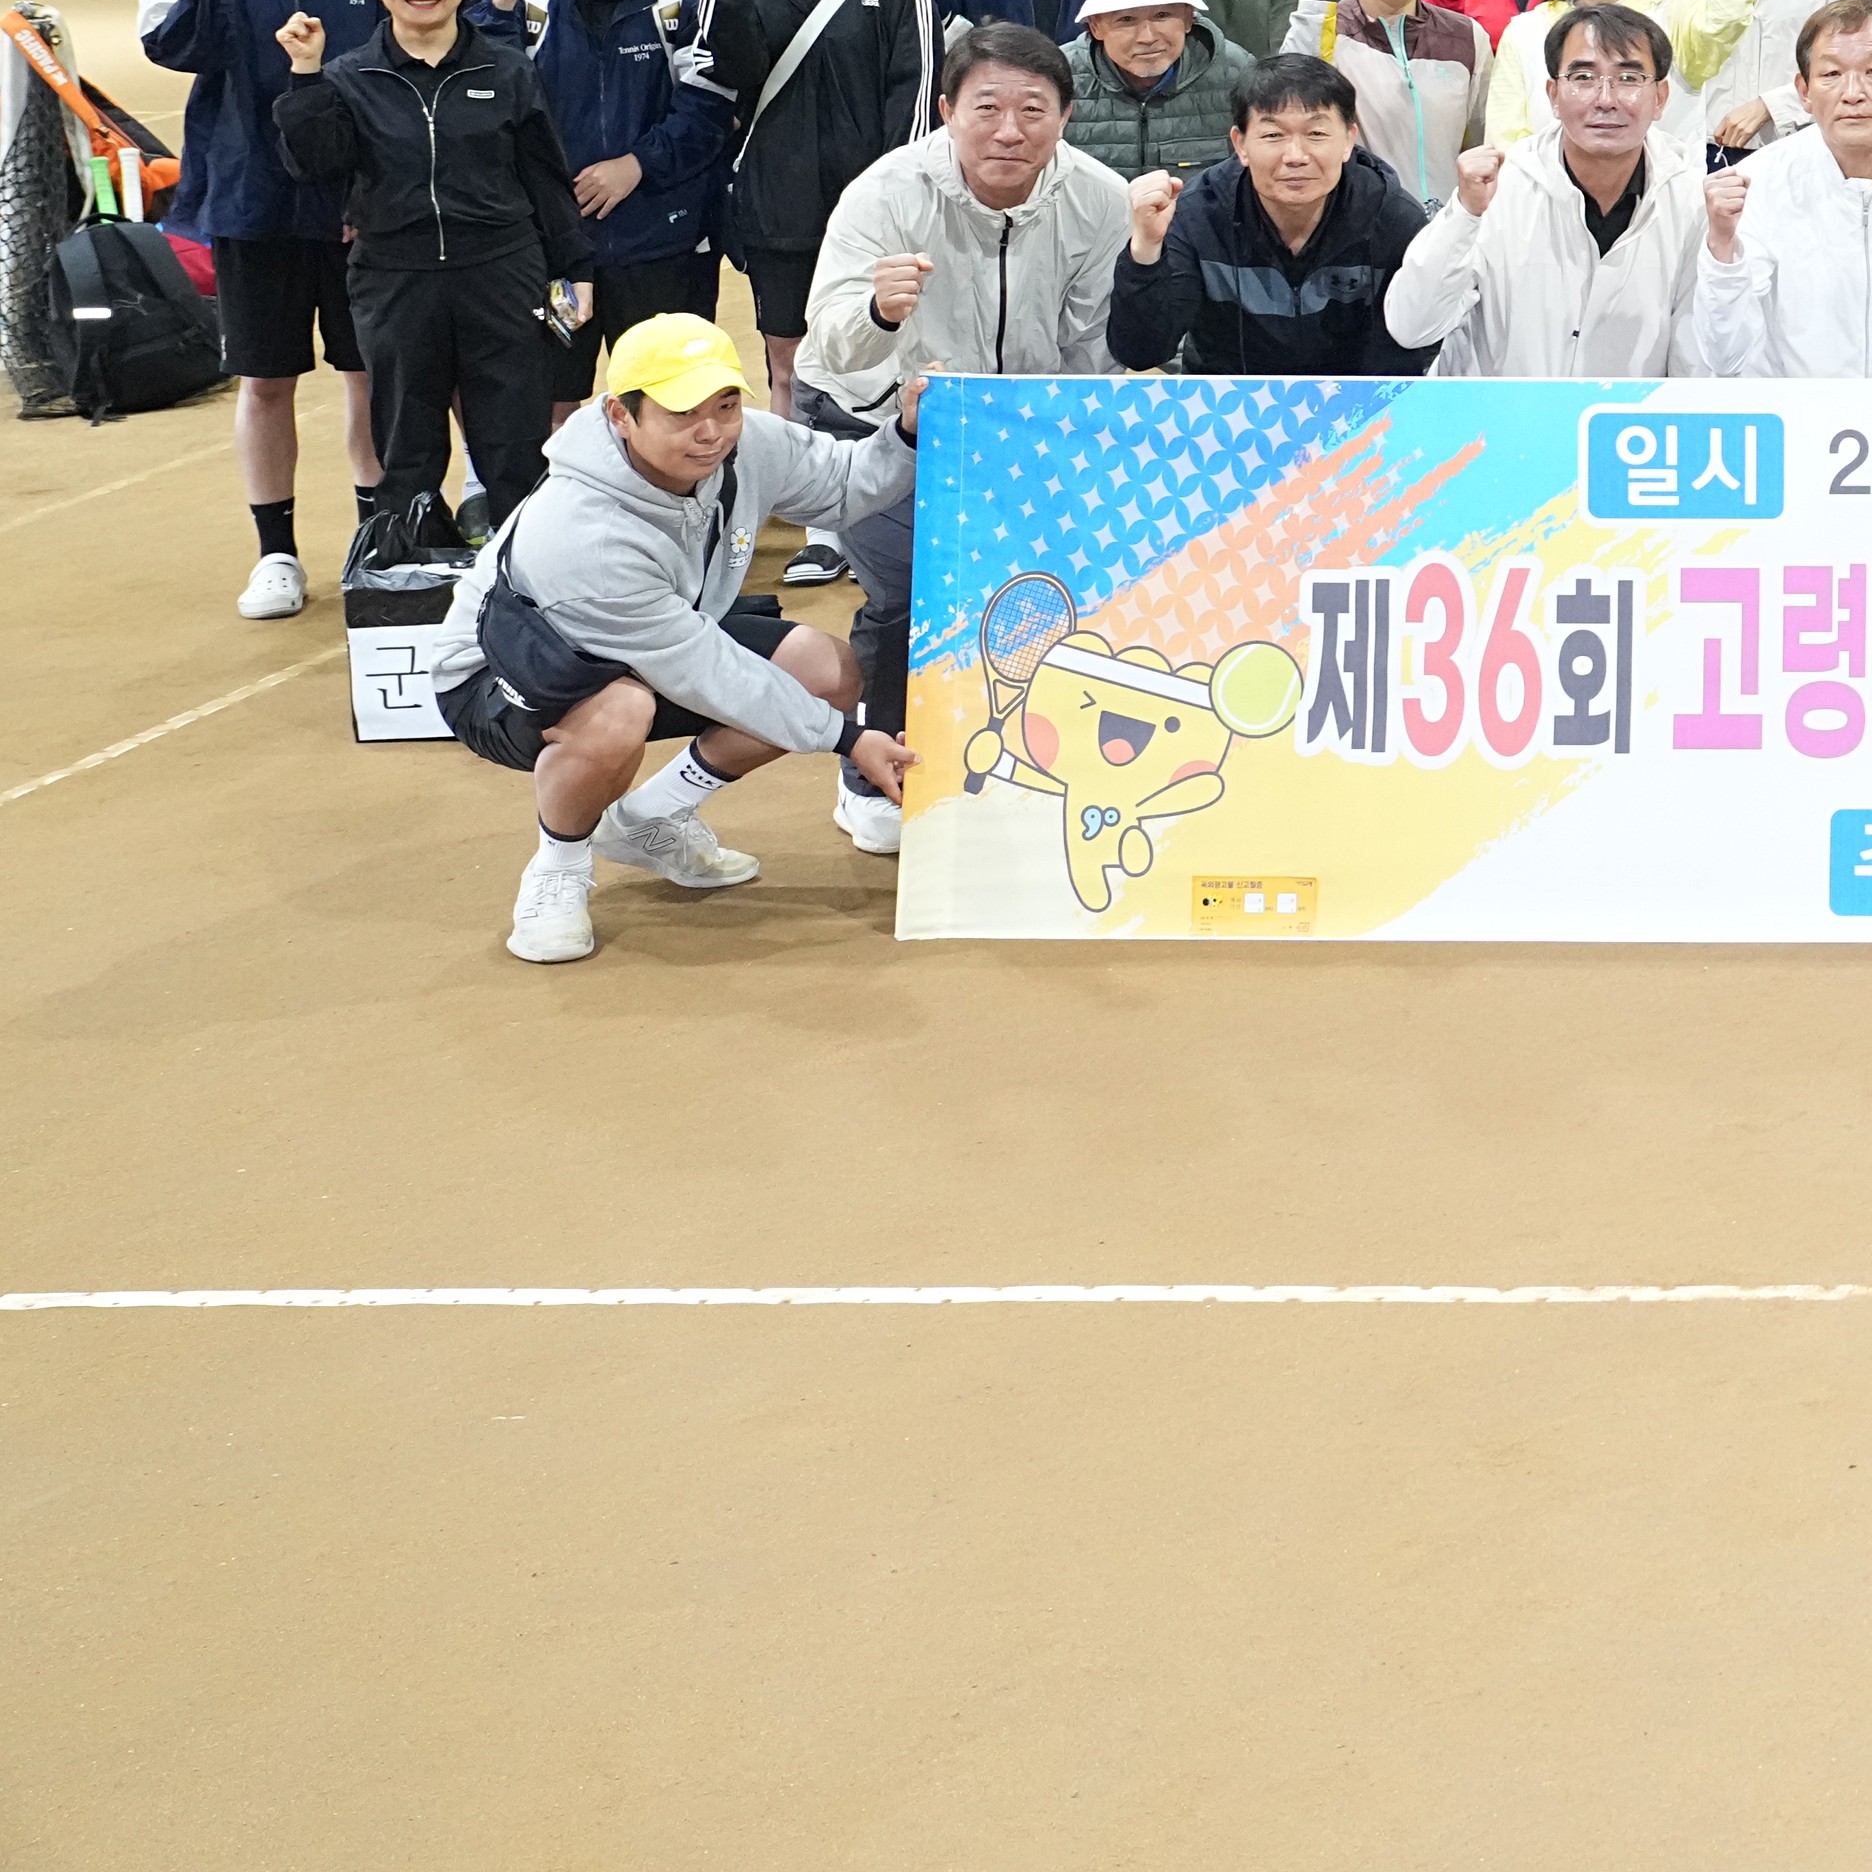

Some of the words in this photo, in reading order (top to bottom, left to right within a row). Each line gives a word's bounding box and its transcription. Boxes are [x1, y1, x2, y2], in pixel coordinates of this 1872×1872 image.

[14, 29, 60, 75] PACIFIC
[618, 44, 638, 56] Tennis
[640, 42, 662, 54] Origin
[633, 52, 650, 62] 1974
[1616, 426, 1756, 505] 일시
[366, 646, 428, 710] 군
[1307, 560, 1633, 756] 제36회
[686, 764, 724, 790] NIK
